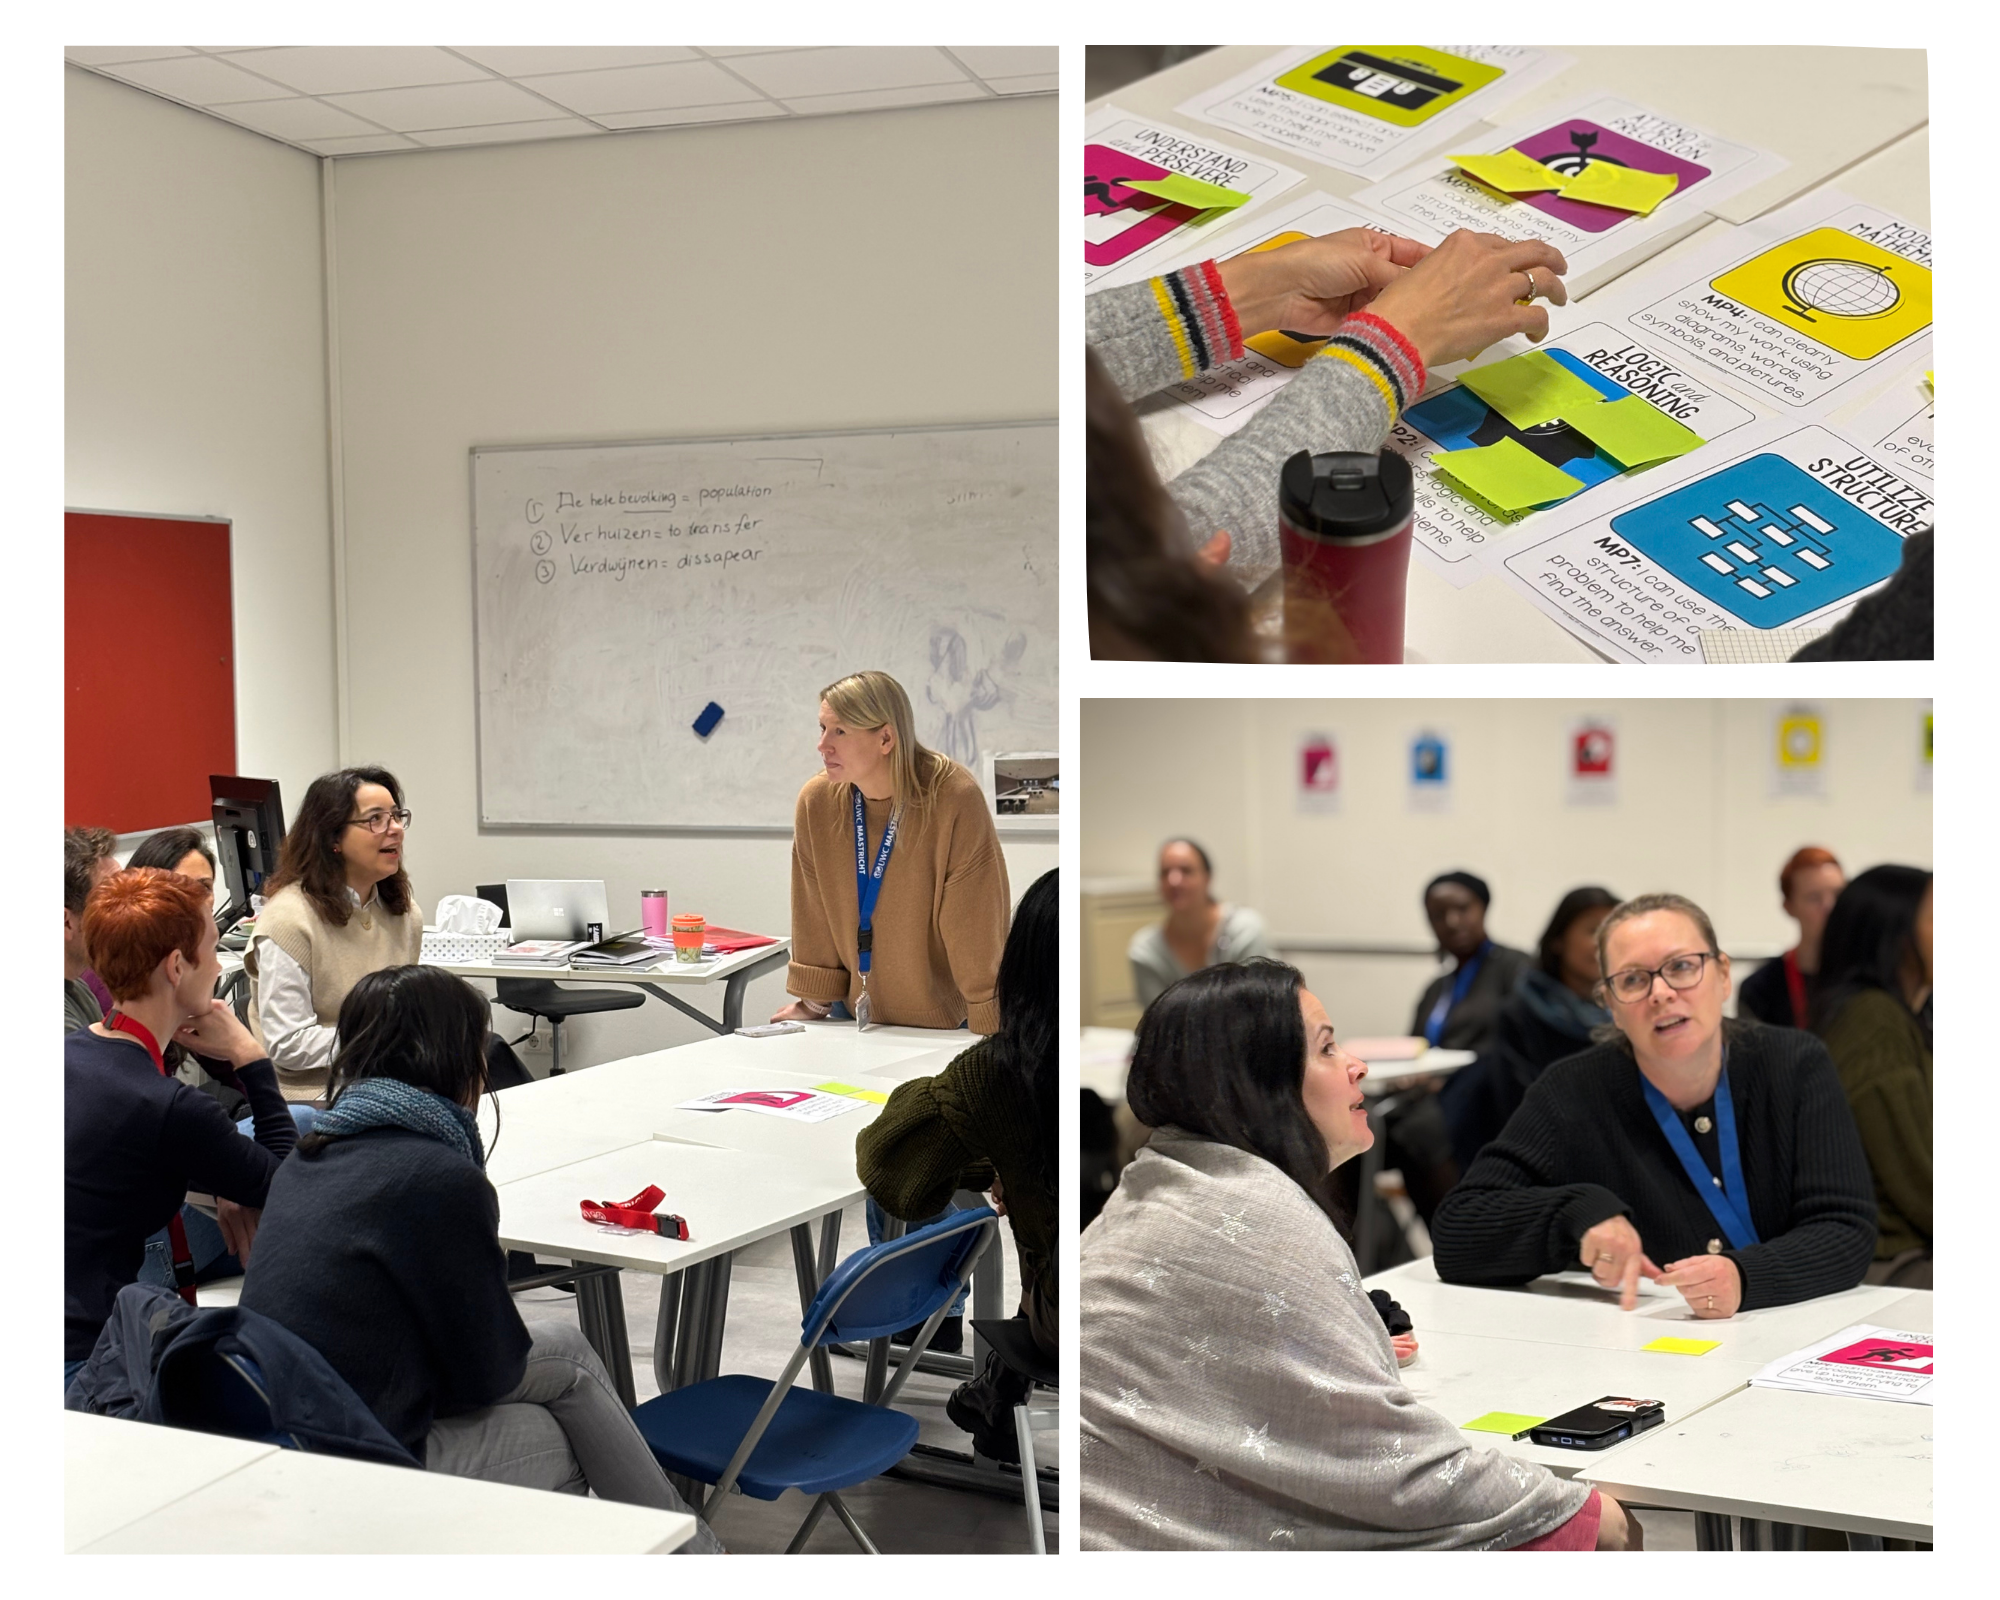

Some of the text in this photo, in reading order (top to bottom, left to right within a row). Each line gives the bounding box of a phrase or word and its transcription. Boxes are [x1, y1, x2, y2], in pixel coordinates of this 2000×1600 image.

[1134, 128, 1249, 174] UNDERSTAND
[1607, 117, 1709, 160] PRECISION
[1628, 114, 1698, 141] ATTEND
[1108, 138, 1240, 188] and PERSEVERE
[1410, 203, 1442, 221] they
[1416, 193, 1488, 228] strategies
[1444, 191, 1552, 243] calculations and
[1512, 206, 1561, 233] review
[1560, 228, 1588, 245] my
[1881, 222, 1931, 252] MODE
[1675, 314, 1746, 354] diagrams,
[1750, 351, 1802, 382] words,
[1678, 299, 1834, 380] show my work using
[1701, 294, 1748, 319] MP4:
[1753, 321, 1783, 338] can
[1783, 335, 1840, 366] clearly
[1246, 360, 1278, 378] and
[1614, 345, 1682, 384] LOGIC
[1670, 382, 1712, 402] and
[1641, 313, 1706, 350] symbols,
[1708, 347, 1743, 365] and
[1735, 362, 1806, 400] pictures.
[1213, 383, 1242, 398] me
[1582, 348, 1700, 419] REASONING
[1884, 442, 1911, 454] of
[699, 486, 773, 507] population
[1427, 479, 1463, 507] logic,
[1464, 505, 1498, 527] and
[1808, 458, 1930, 535] STRUCTURE
[1844, 456, 1934, 516] UTILIZE
[668, 524, 682, 537] to
[1436, 506, 1454, 522] to
[1451, 520, 1485, 544] help
[676, 548, 764, 570] dissapear
[1594, 536, 1642, 570] MP7:
[1644, 575, 1676, 597] can
[1674, 594, 1707, 616] use
[1546, 554, 1697, 655] problem to help me
[1586, 556, 1664, 612] structure
[1663, 610, 1691, 624] of
[1539, 571, 1578, 599] find
[1572, 595, 1602, 617] the
[1600, 616, 1664, 658] answer.
[856, 825, 866, 875] MAASTRICHT
[877, 846, 890, 866] UWC
